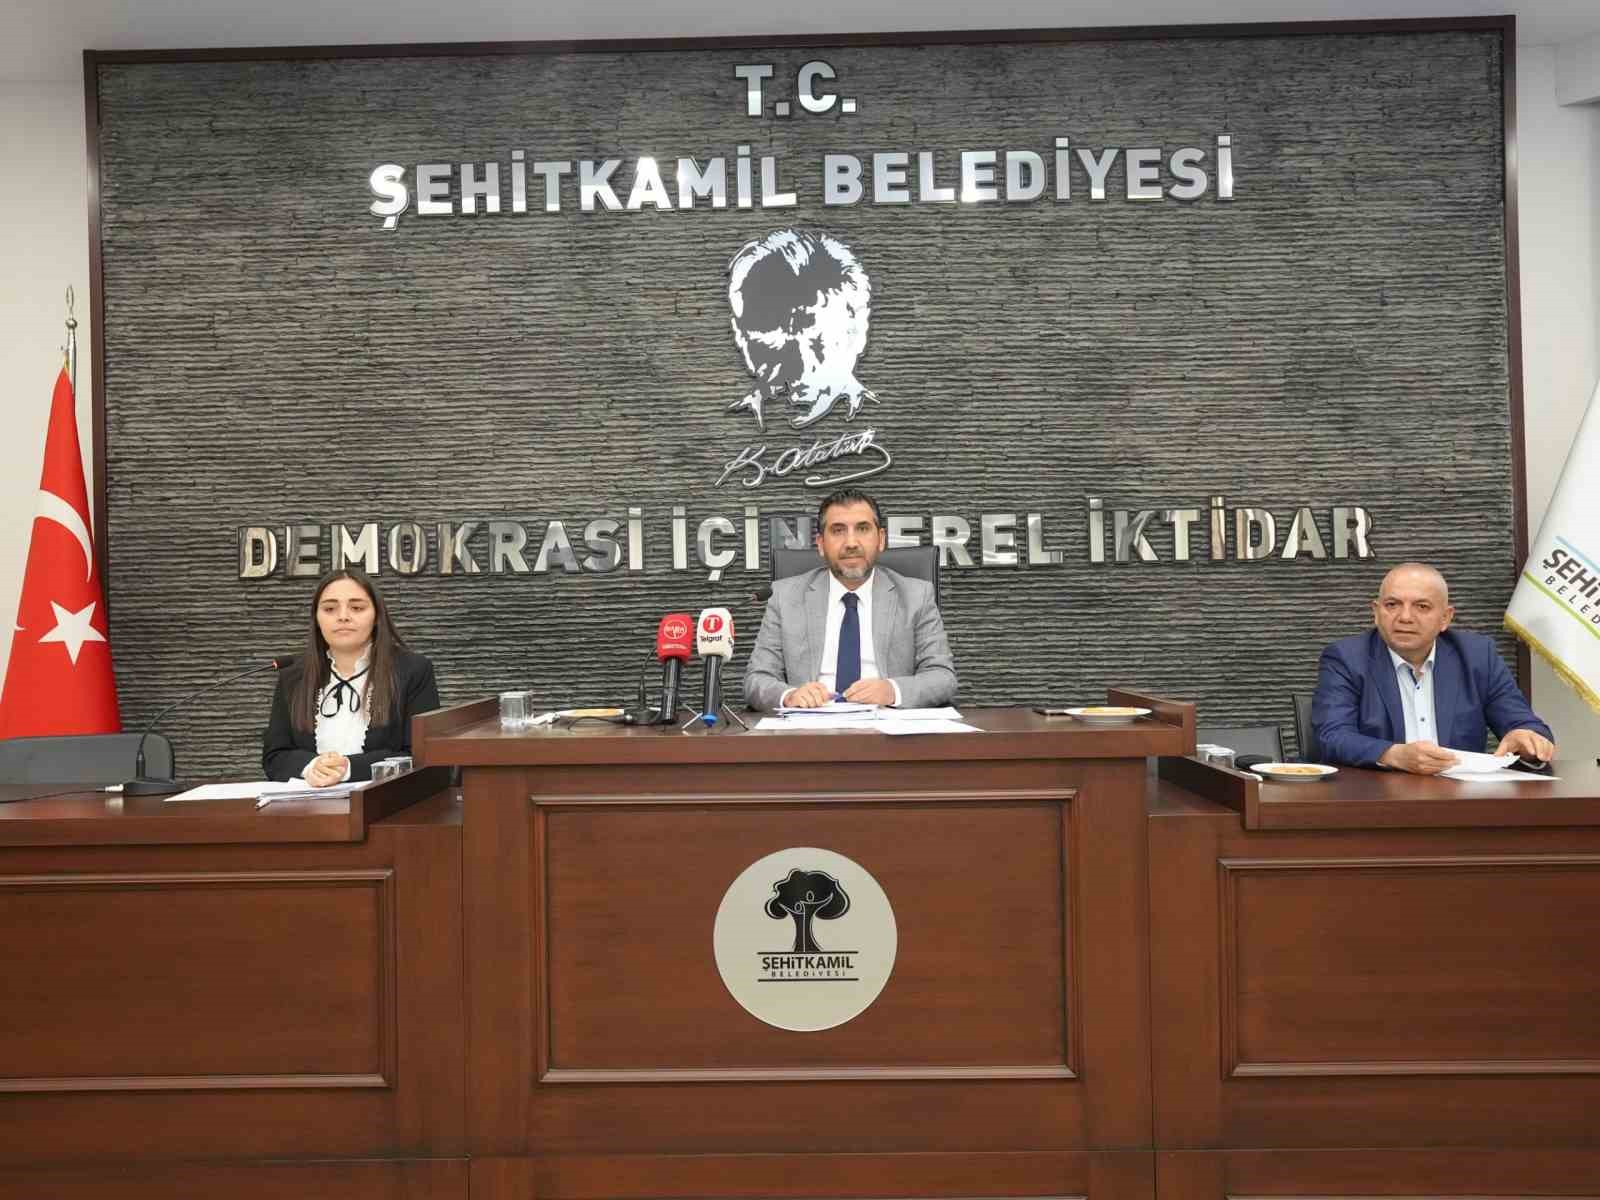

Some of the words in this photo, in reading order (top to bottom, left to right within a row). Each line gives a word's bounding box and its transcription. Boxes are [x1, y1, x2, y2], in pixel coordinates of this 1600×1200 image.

[734, 61, 857, 116] T.C.
[369, 144, 797, 230] ŞEHİTKAMİL
[823, 134, 1234, 206] BELEDİYESİ
[237, 506, 644, 578] DEMOKRASİ
[672, 505, 812, 581] İÇİN
[887, 512, 1064, 568] EREL
[1089, 496, 1376, 563] İKTİDAR
[762, 956, 854, 971] ŞEHİTKAMİL
